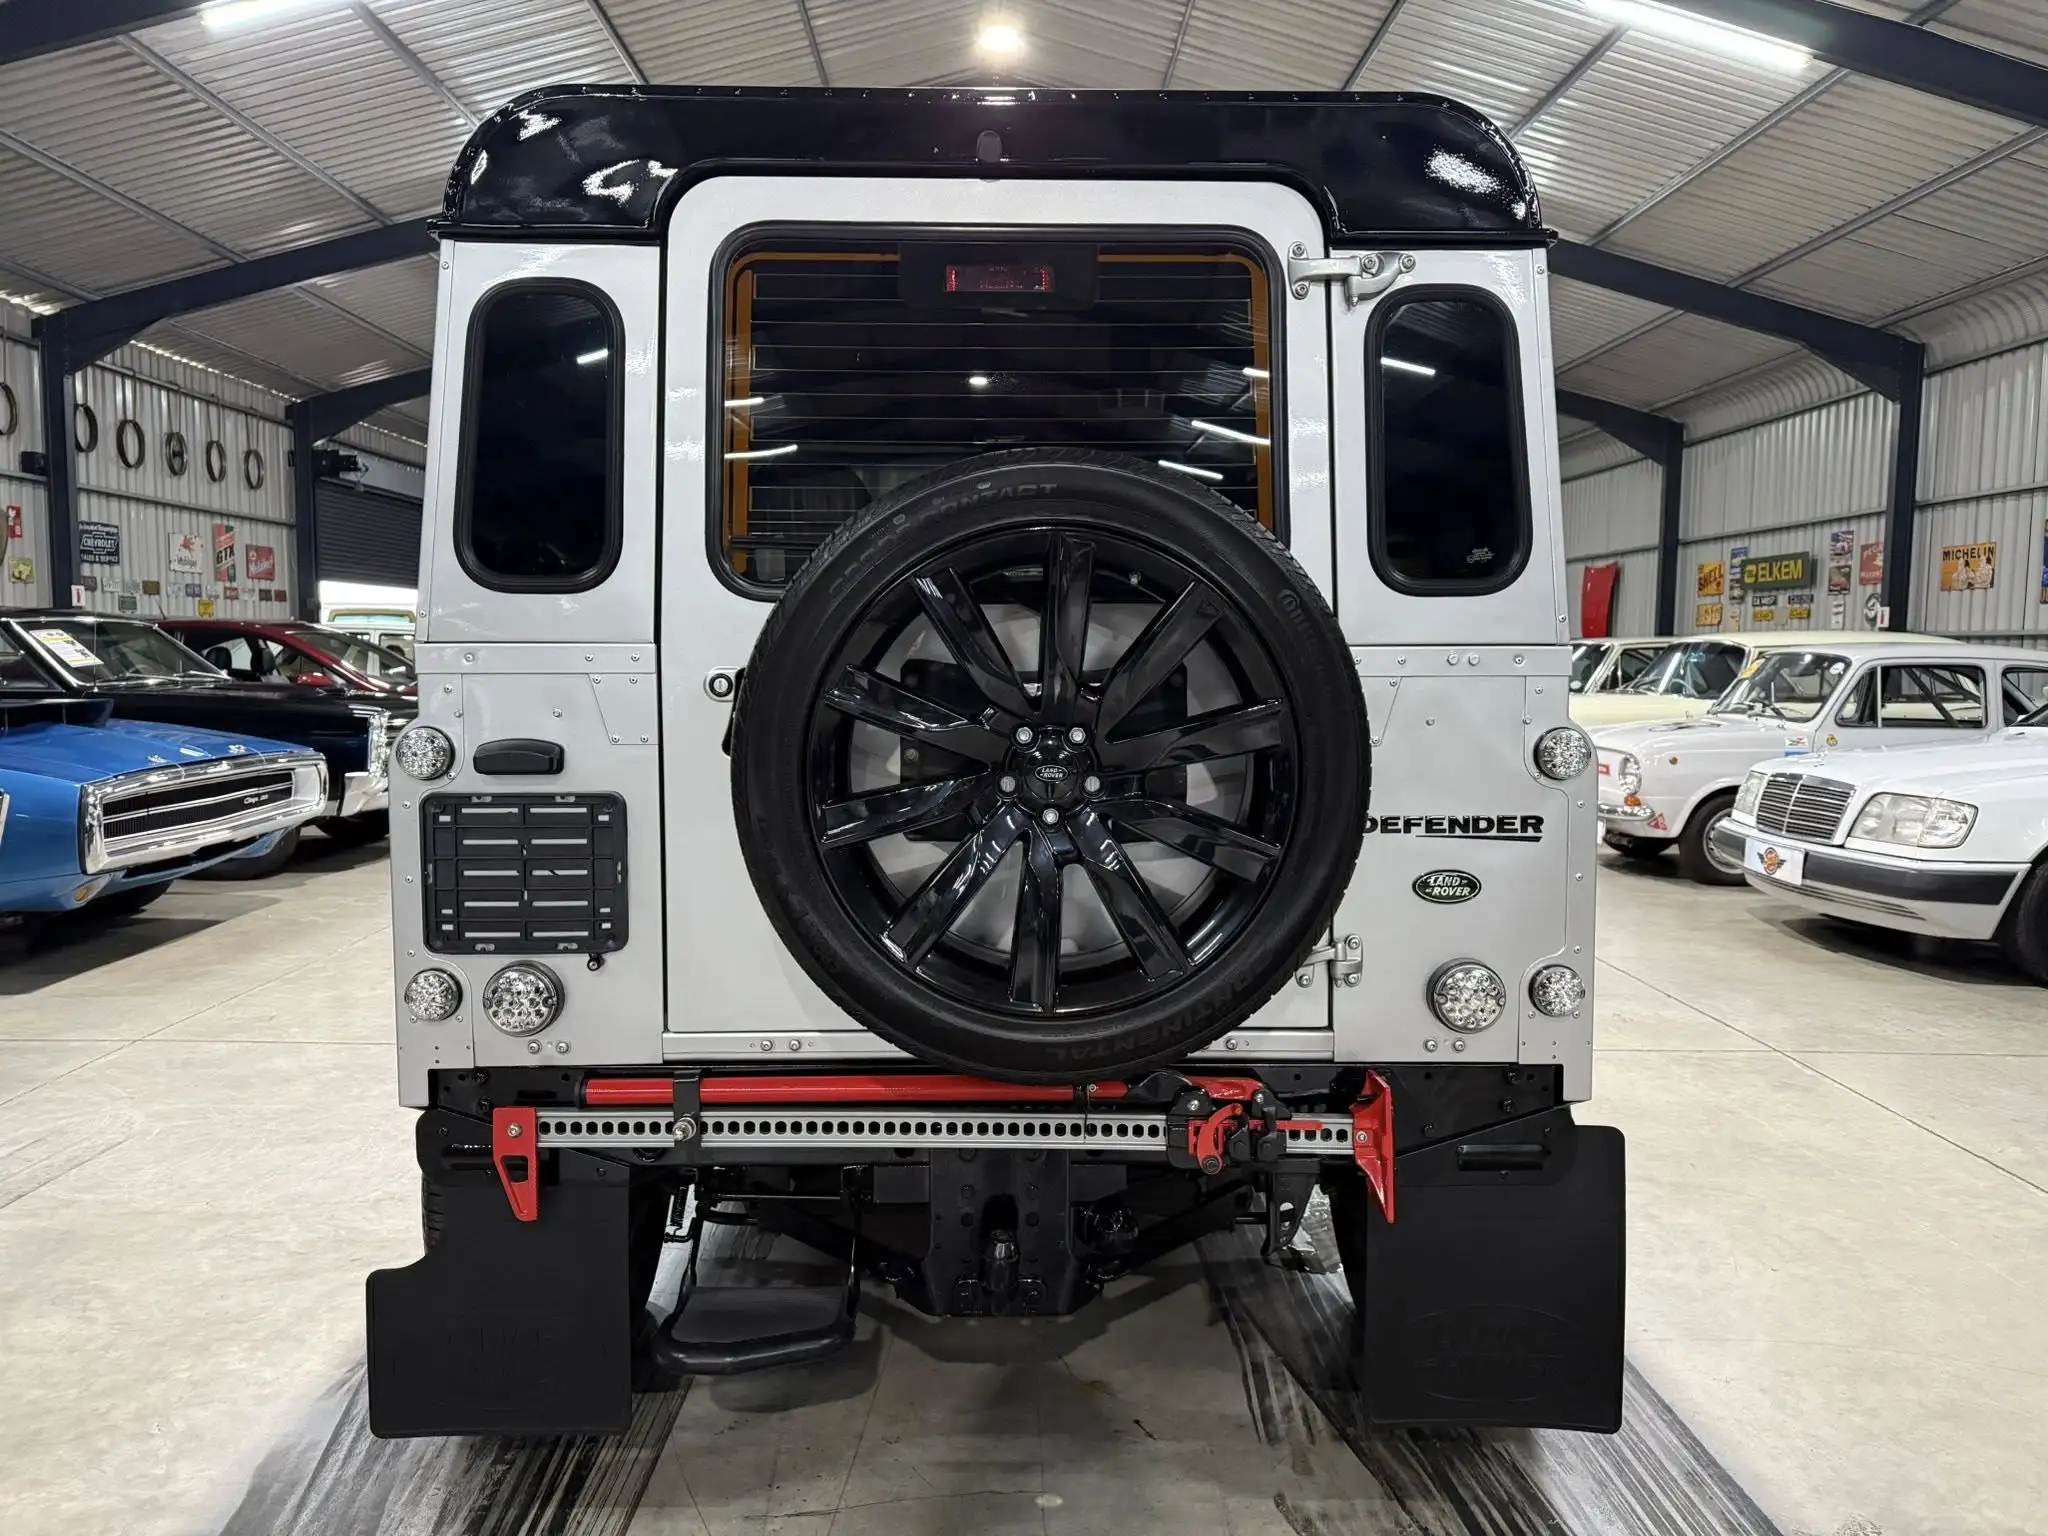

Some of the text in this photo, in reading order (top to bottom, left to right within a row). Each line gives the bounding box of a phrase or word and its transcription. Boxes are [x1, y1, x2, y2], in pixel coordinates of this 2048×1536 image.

[83, 538, 115, 549] CHEVROLET
[1942, 546, 1995, 561] MICHELIN
[1362, 815, 1545, 834] DEFENDER
[1429, 876, 1460, 887] LAND
[1432, 887, 1471, 896] ROVER
